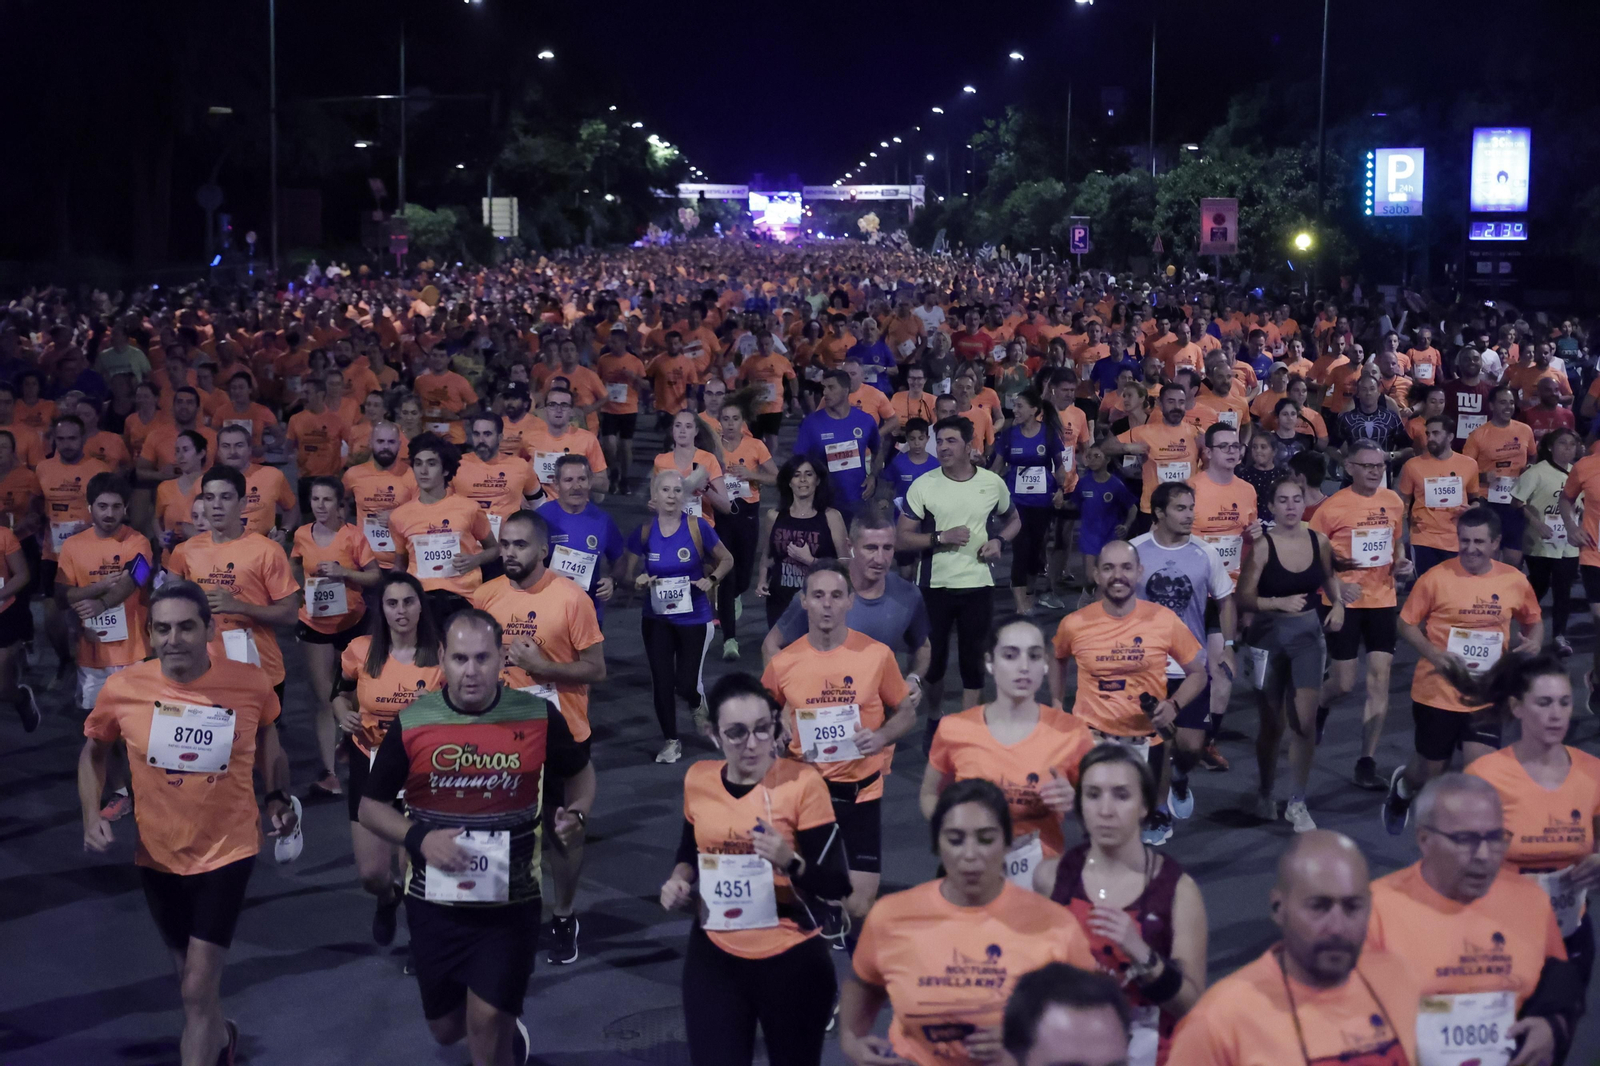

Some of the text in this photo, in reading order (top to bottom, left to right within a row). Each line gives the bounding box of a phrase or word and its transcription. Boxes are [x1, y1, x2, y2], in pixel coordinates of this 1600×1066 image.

[1388, 154, 1415, 193] P
[1399, 184, 1414, 193] 24h
[1382, 203, 1411, 214] saba
[1074, 228, 1085, 242] P
[1021, 475, 1041, 483] 17392
[1164, 471, 1185, 480] 12411
[1433, 486, 1456, 495] 13568
[774, 528, 820, 543] SWEAT
[1362, 540, 1387, 552] 20557
[424, 549, 452, 561] 20939
[561, 560, 587, 574] 17418
[313, 590, 335, 601] 5299
[658, 589, 684, 600] 17384
[506, 622, 538, 630] NOCTURNA
[1463, 644, 1490, 658] 9028
[1095, 654, 1126, 662] SEVILLA
[375, 696, 409, 704] SEVILLA
[805, 696, 837, 704] SEVILLA
[174, 726, 213, 745] 8709
[814, 724, 846, 740] 2693
[432, 744, 521, 772] Gorras
[429, 771, 523, 791] runners
[1003, 858, 1029, 876] 08
[714, 879, 752, 898] 4351
[945, 965, 1007, 975] NOCTURNA
[1435, 965, 1482, 976] SEVILLA
[917, 976, 972, 988] SEVILLA
[1440, 1022, 1499, 1047] 10806
